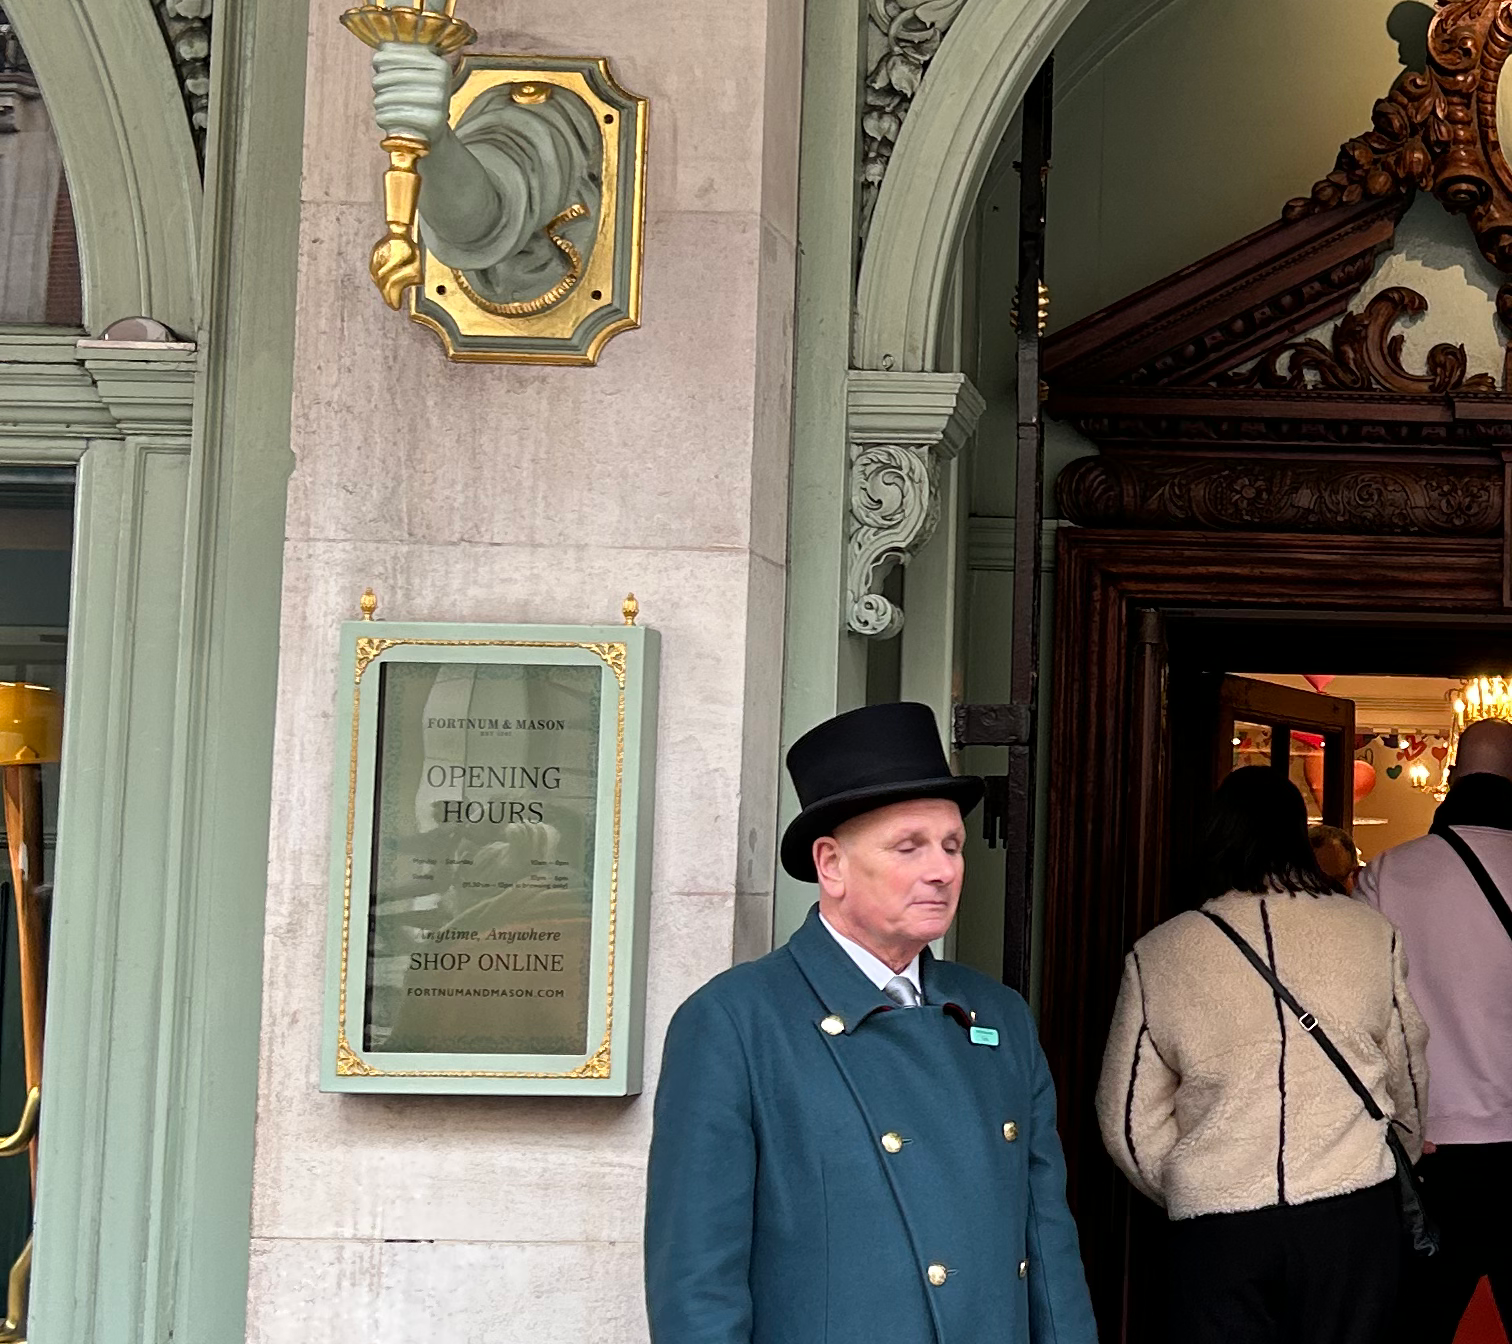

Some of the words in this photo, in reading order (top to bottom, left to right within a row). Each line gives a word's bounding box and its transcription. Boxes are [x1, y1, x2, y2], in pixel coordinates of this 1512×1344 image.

[427, 718, 498, 729] FORTNUM
[502, 719, 512, 729] &
[516, 719, 565, 730] MASON
[427, 765, 561, 789] OPENING
[443, 801, 544, 824] HOURS
[417, 928, 480, 943] Anytime,
[485, 928, 561, 944] Anywhere
[410, 953, 471, 971] SHOP
[478, 953, 564, 971] ONLINE
[407, 988, 565, 998] FORTNUMANDMASON.COM
